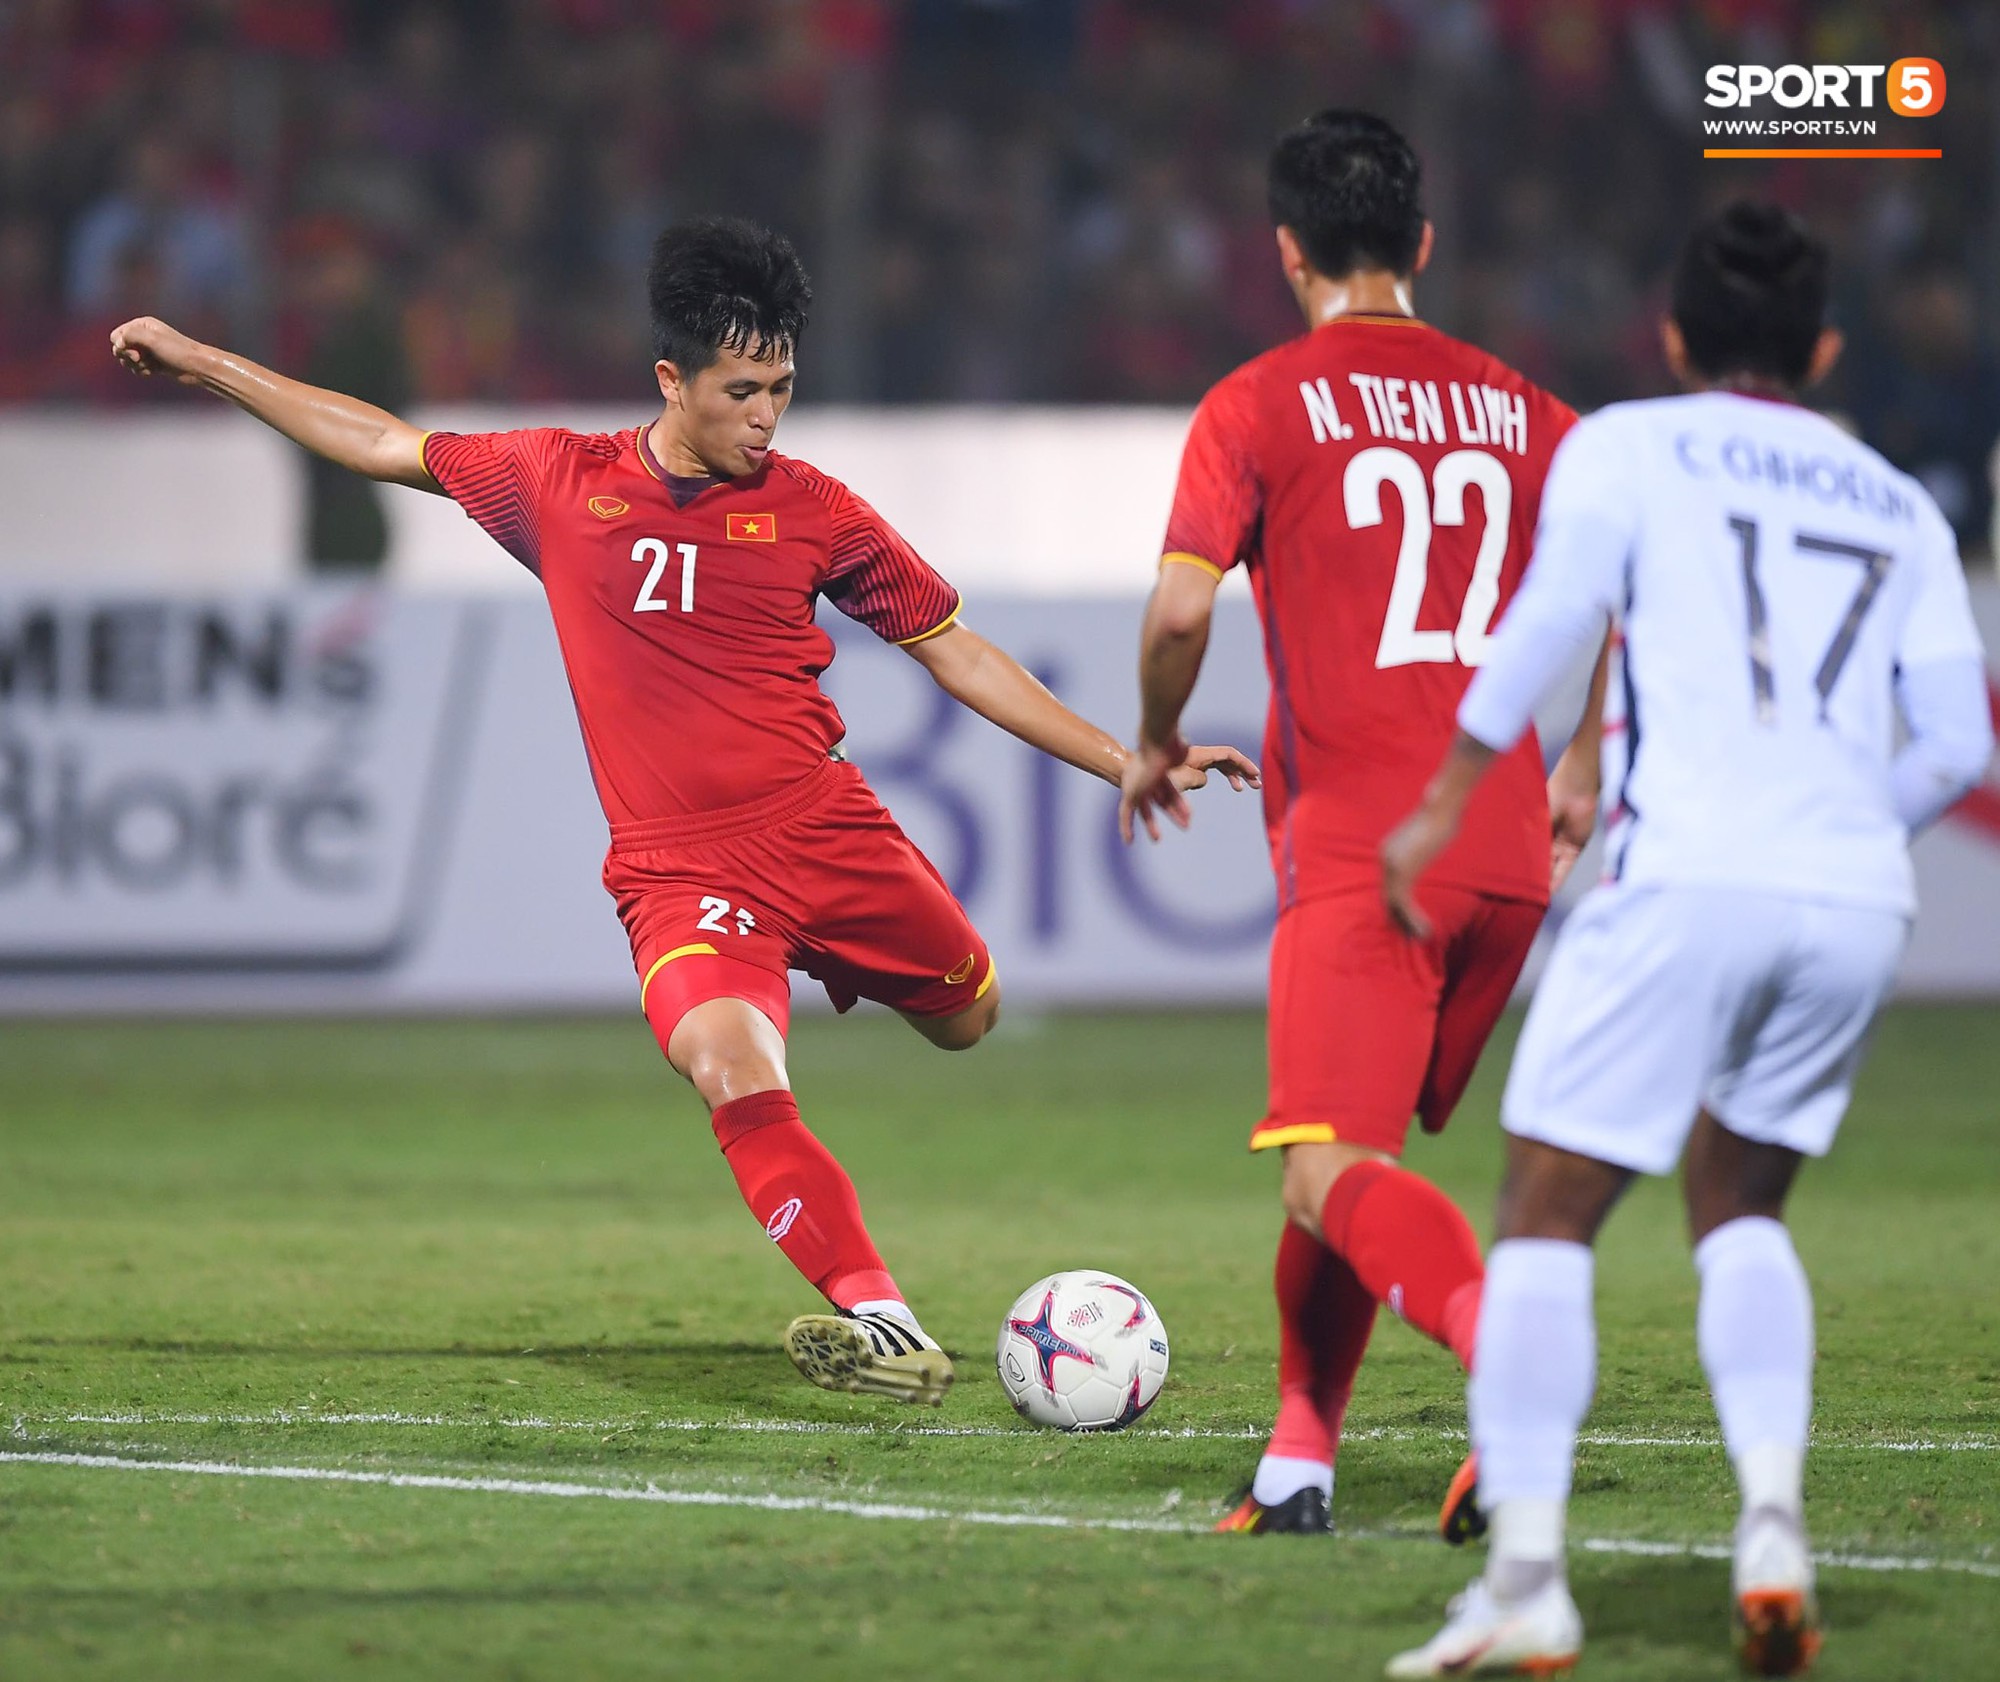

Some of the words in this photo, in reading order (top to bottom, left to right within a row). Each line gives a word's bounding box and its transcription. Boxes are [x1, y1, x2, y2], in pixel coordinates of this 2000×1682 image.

[1299, 376, 1354, 444] N.
[1348, 372, 1448, 445] TIEN
[1449, 381, 1528, 457] LINH
[631, 537, 698, 613] 21
[1342, 445, 1513, 670] 22
[1727, 514, 1894, 726] 17
